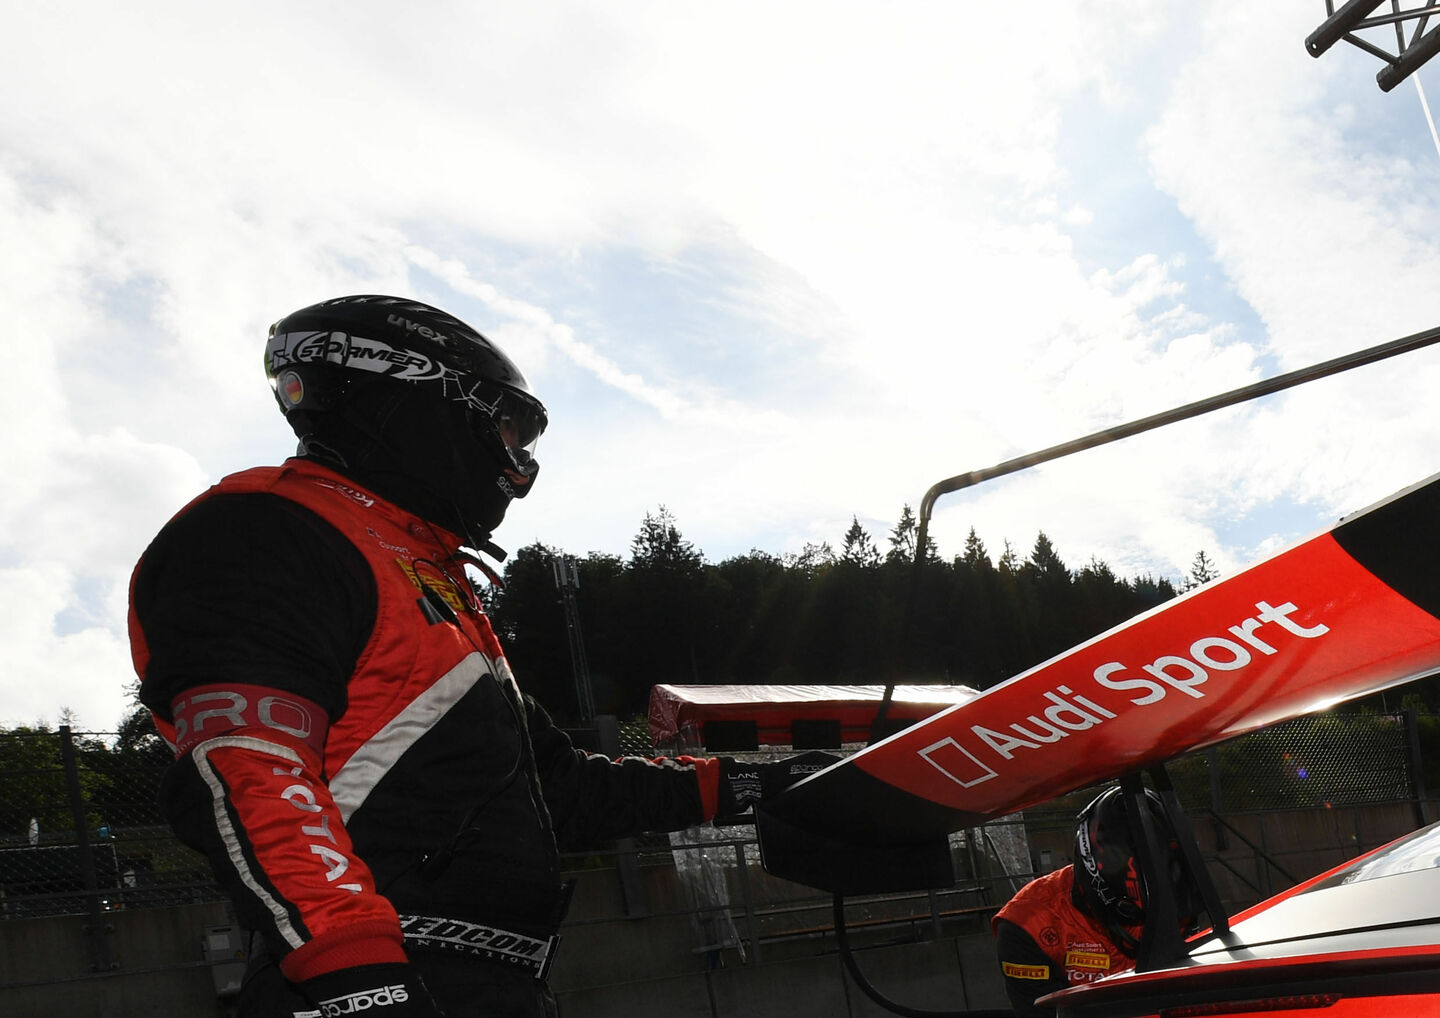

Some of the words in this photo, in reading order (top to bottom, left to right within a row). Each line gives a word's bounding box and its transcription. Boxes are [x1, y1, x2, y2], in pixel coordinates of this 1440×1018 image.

[386, 313, 449, 346] uvex
[972, 685, 1117, 760] Audi
[1093, 600, 1330, 706] Sport
[401, 917, 546, 957] EDCOM
[404, 938, 542, 969] NICATIONS
[1065, 968, 1110, 981] TOTA
[322, 985, 409, 1018] sparco
